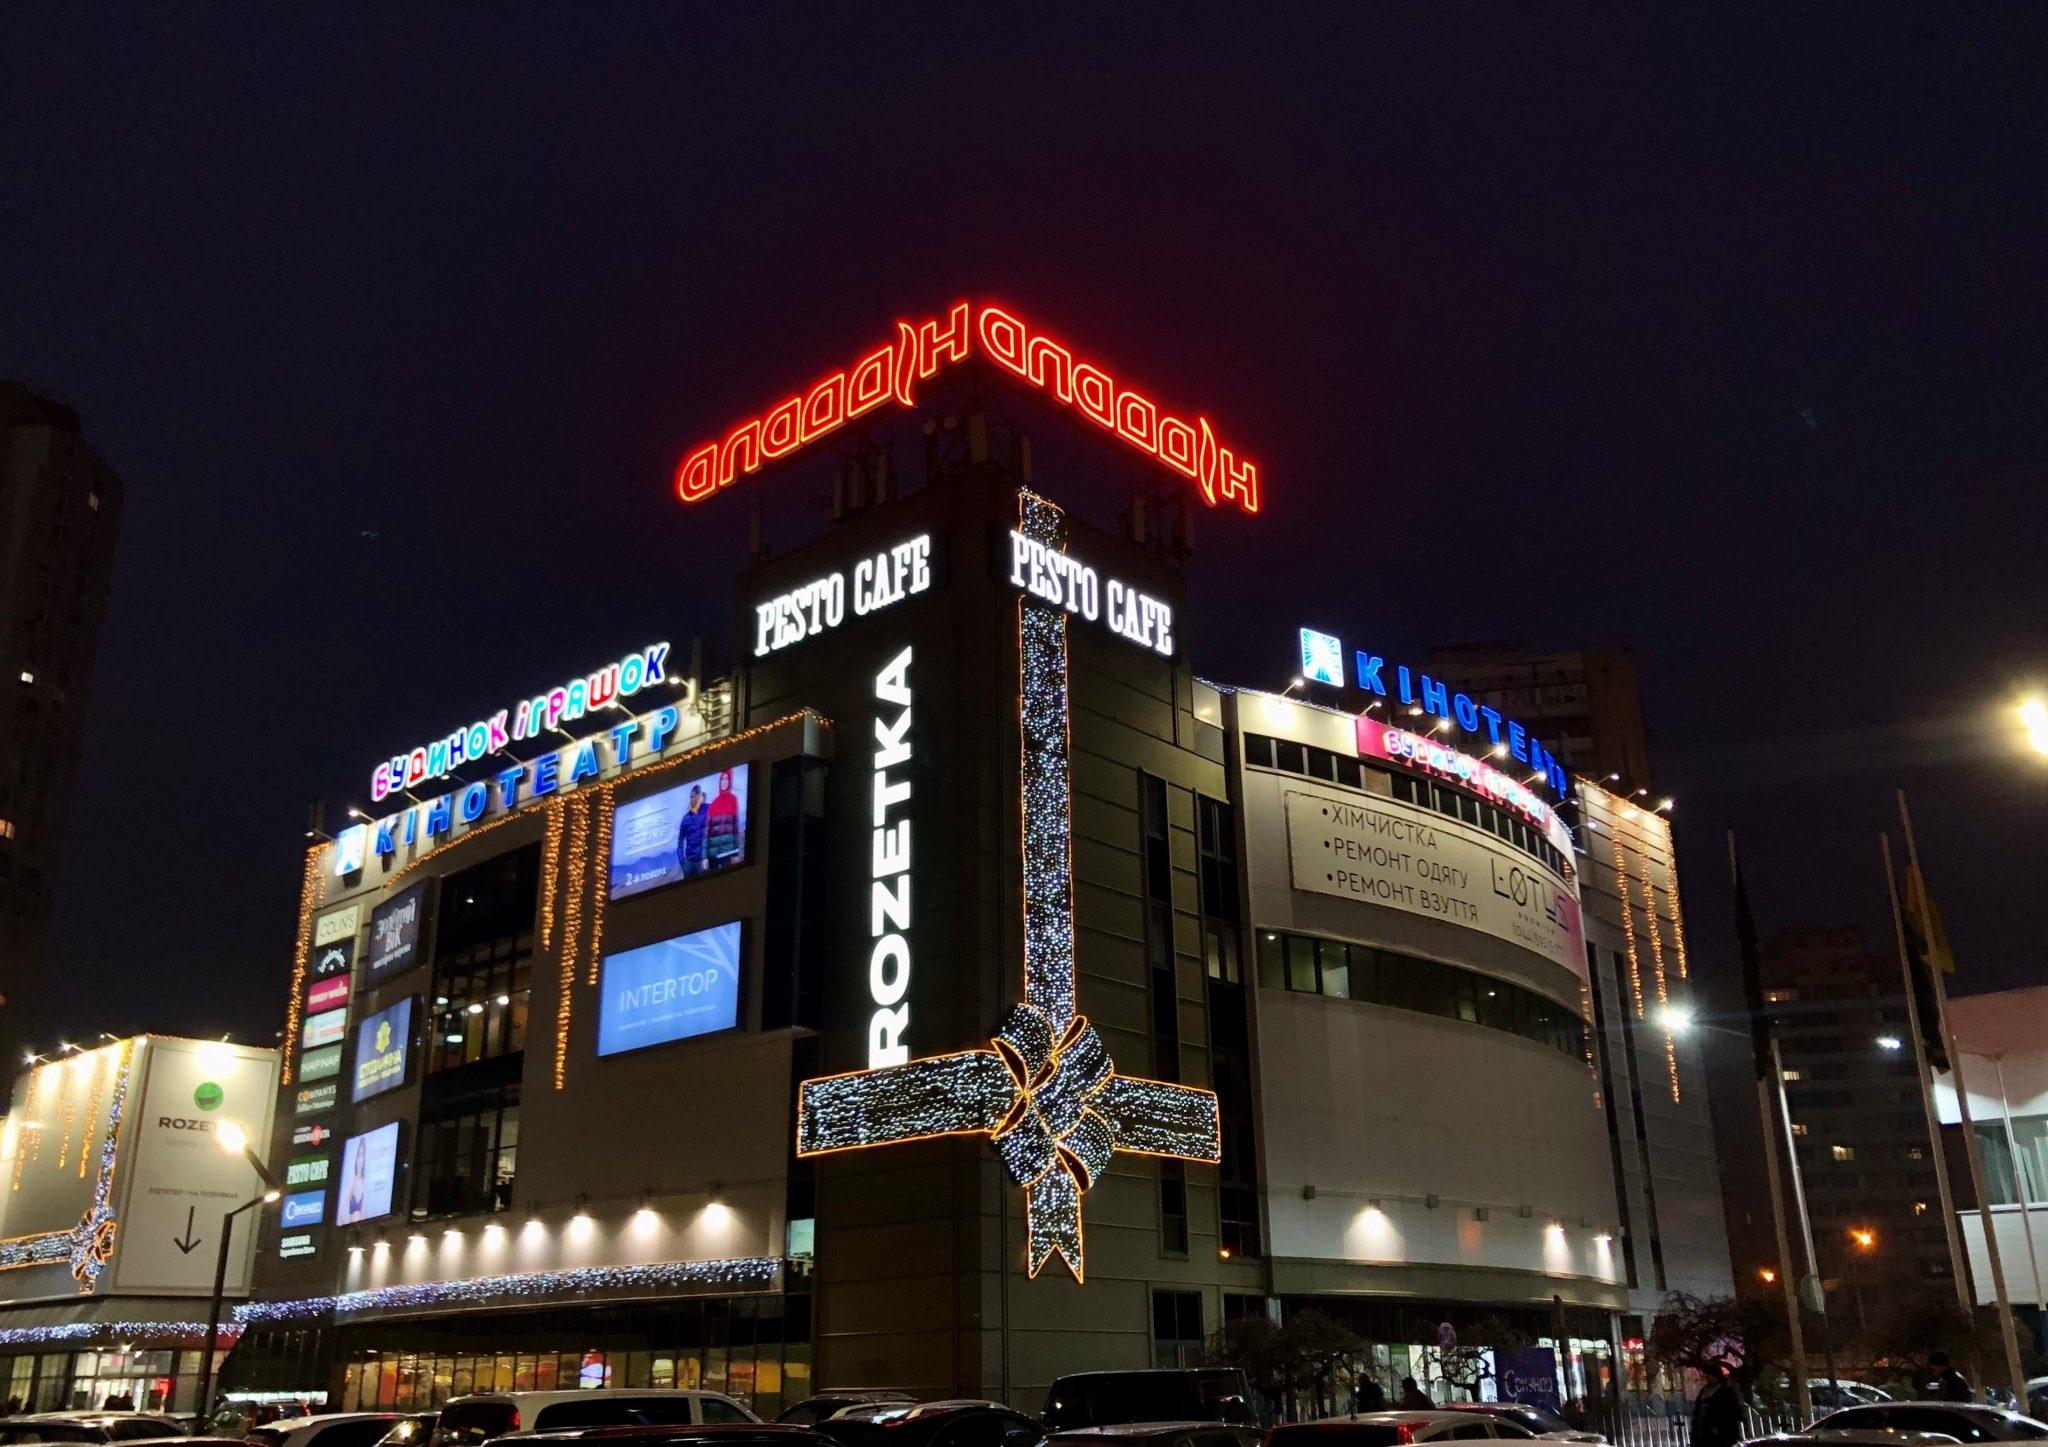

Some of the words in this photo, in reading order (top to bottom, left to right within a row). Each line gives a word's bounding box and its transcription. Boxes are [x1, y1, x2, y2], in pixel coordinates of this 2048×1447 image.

[754, 572, 847, 657] PESTO
[854, 534, 931, 616] CAFE
[1010, 529, 1100, 622] PESTO
[1107, 578, 1174, 657] CAFE
[371, 709, 508, 802] БУДИНОК
[1356, 650, 1567, 800] КІНОТЕАТР
[375, 706, 679, 856] КІНОТЕАТР
[1332, 804, 1438, 850] ХІМЧИСТКА
[869, 646, 913, 1070] ROZETKA
[1334, 837, 1411, 874] РЕМОНТ
[1417, 858, 1468, 889] ОДЯГУ
[1337, 870, 1414, 905] РЕМОНТ
[1420, 889, 1478, 923] ВЗУТТЯ
[620, 968, 718, 1012] INTERTOP
